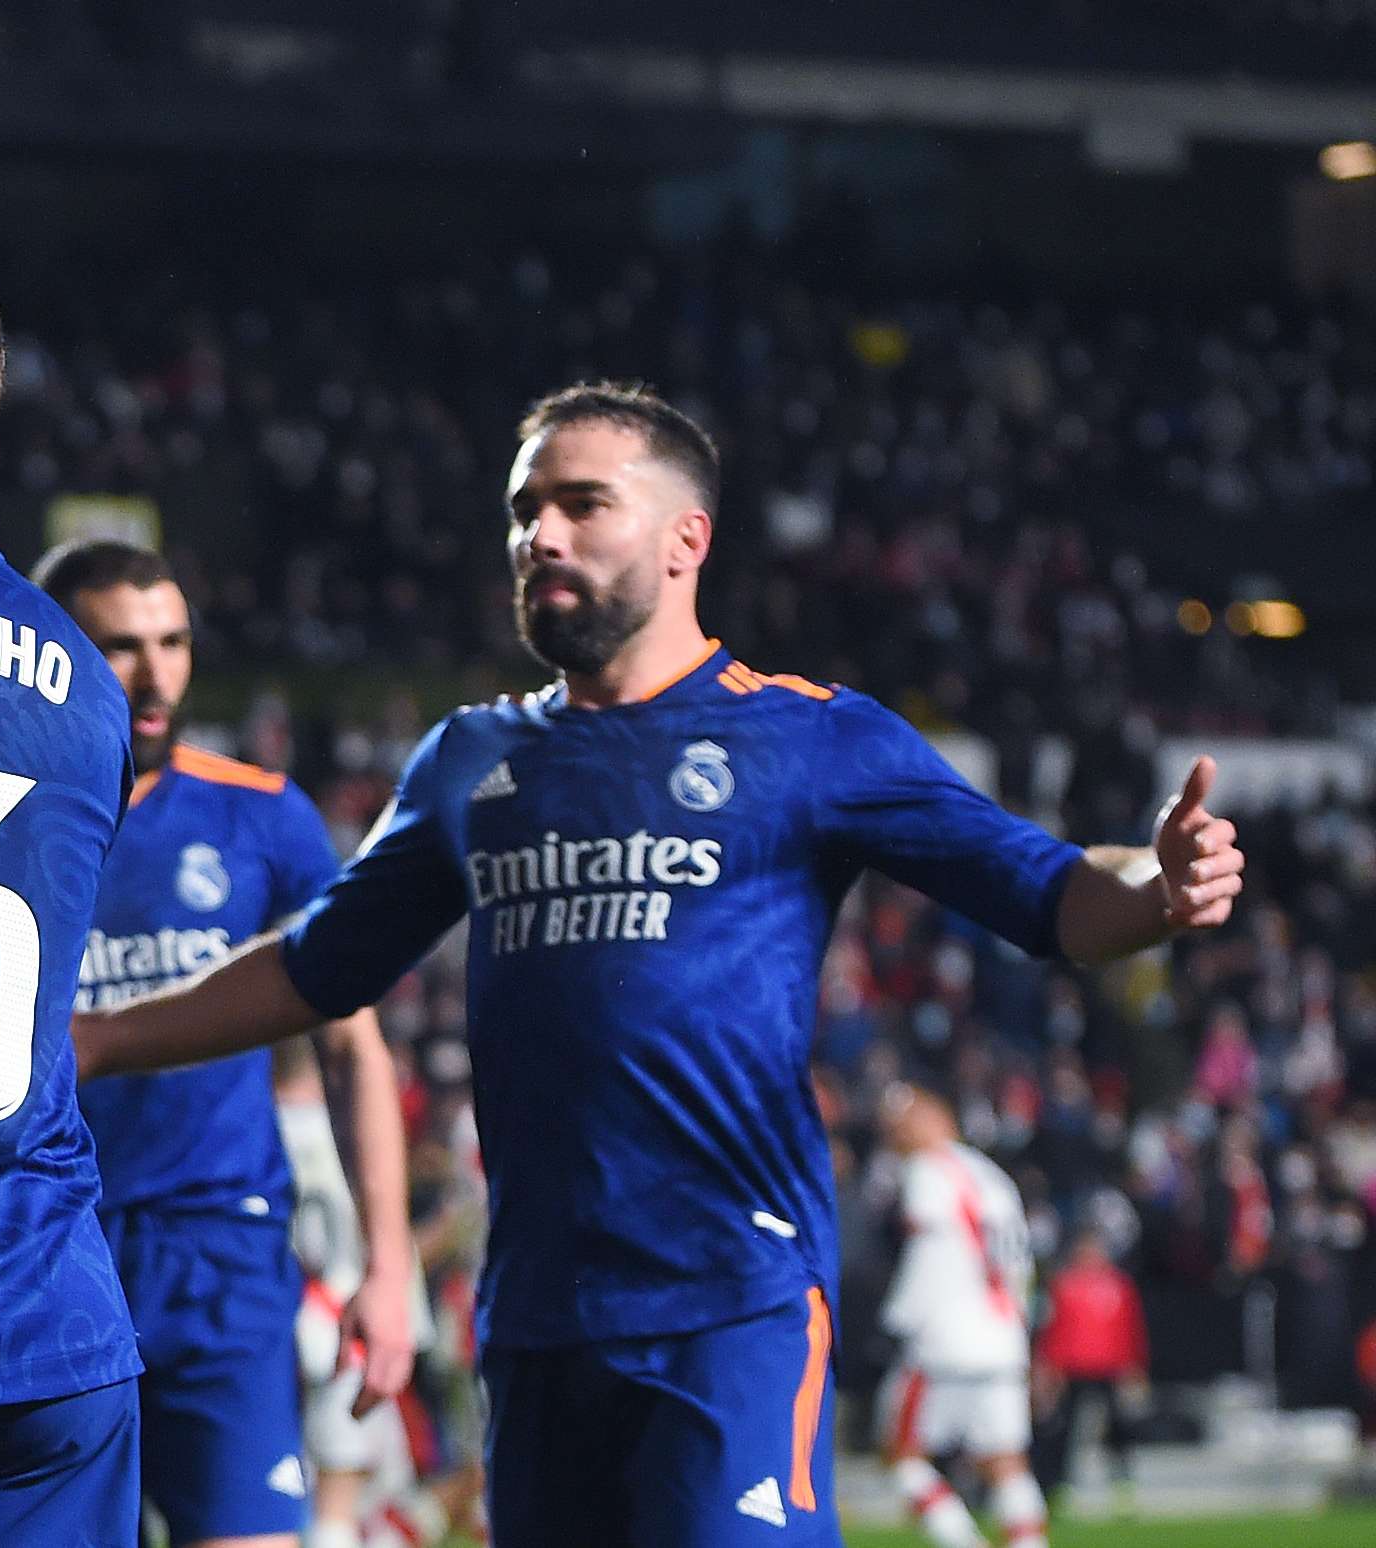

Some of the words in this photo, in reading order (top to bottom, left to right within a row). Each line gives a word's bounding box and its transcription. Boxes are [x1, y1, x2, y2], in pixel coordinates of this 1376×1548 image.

[468, 829, 723, 907] Emirates
[79, 926, 232, 979] irates
[493, 902, 535, 956] FLY
[543, 890, 673, 946] BETTER
